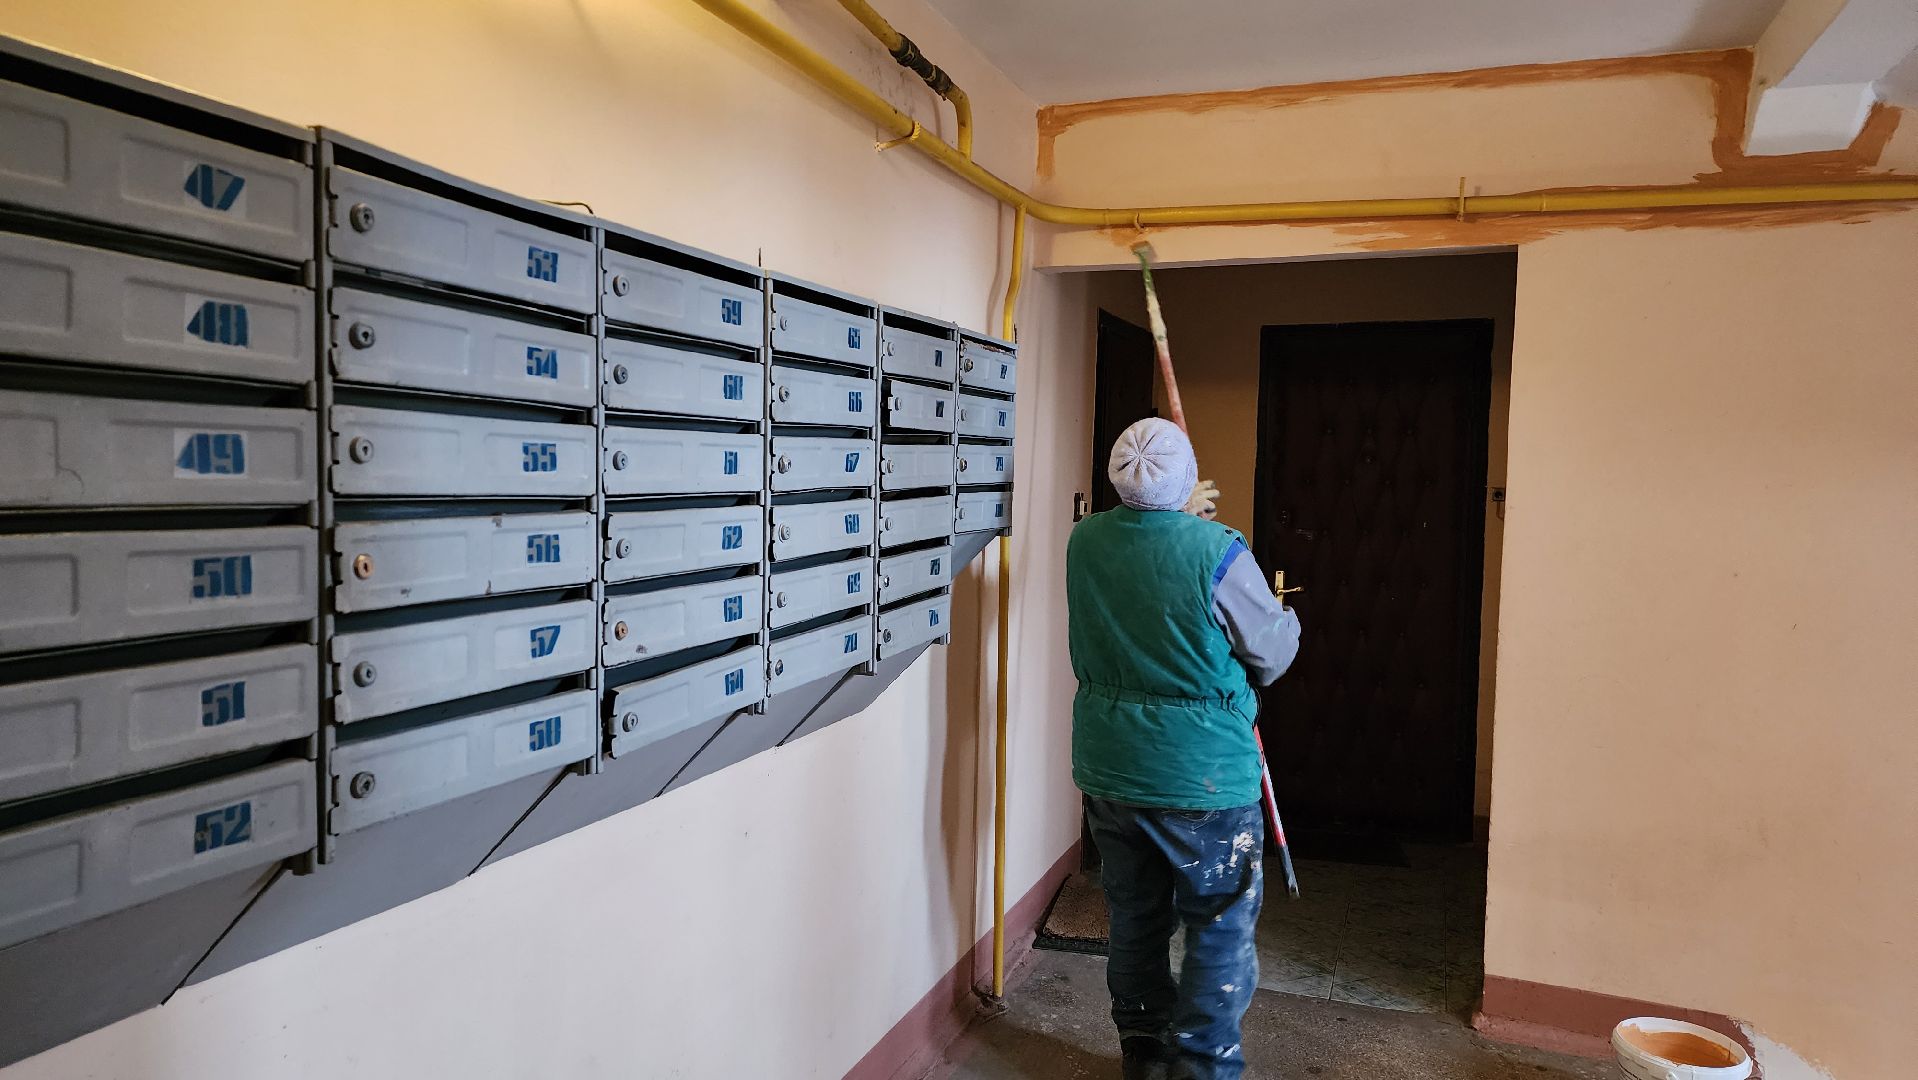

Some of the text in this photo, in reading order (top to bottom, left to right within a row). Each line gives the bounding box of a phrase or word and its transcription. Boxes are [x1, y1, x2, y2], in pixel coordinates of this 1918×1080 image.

[528, 246, 557, 283] 53
[721, 299, 742, 325] 59
[848, 327, 861, 349] 65
[527, 346, 557, 379] 54
[848, 391, 862, 412] 66
[177, 433, 245, 475] 49
[523, 443, 557, 472] 55
[845, 452, 859, 473] 67
[996, 457, 1003, 471] 79
[527, 533, 560, 563] 56
[722, 525, 742, 550] 62
[193, 556, 251, 598] 50
[930, 558, 940, 575] 75
[723, 595, 742, 622] 63
[530, 625, 560, 658] 57
[844, 632, 857, 653] 70
[725, 668, 743, 696] 64
[201, 681, 245, 726] 51
[194, 802, 251, 853] 52
